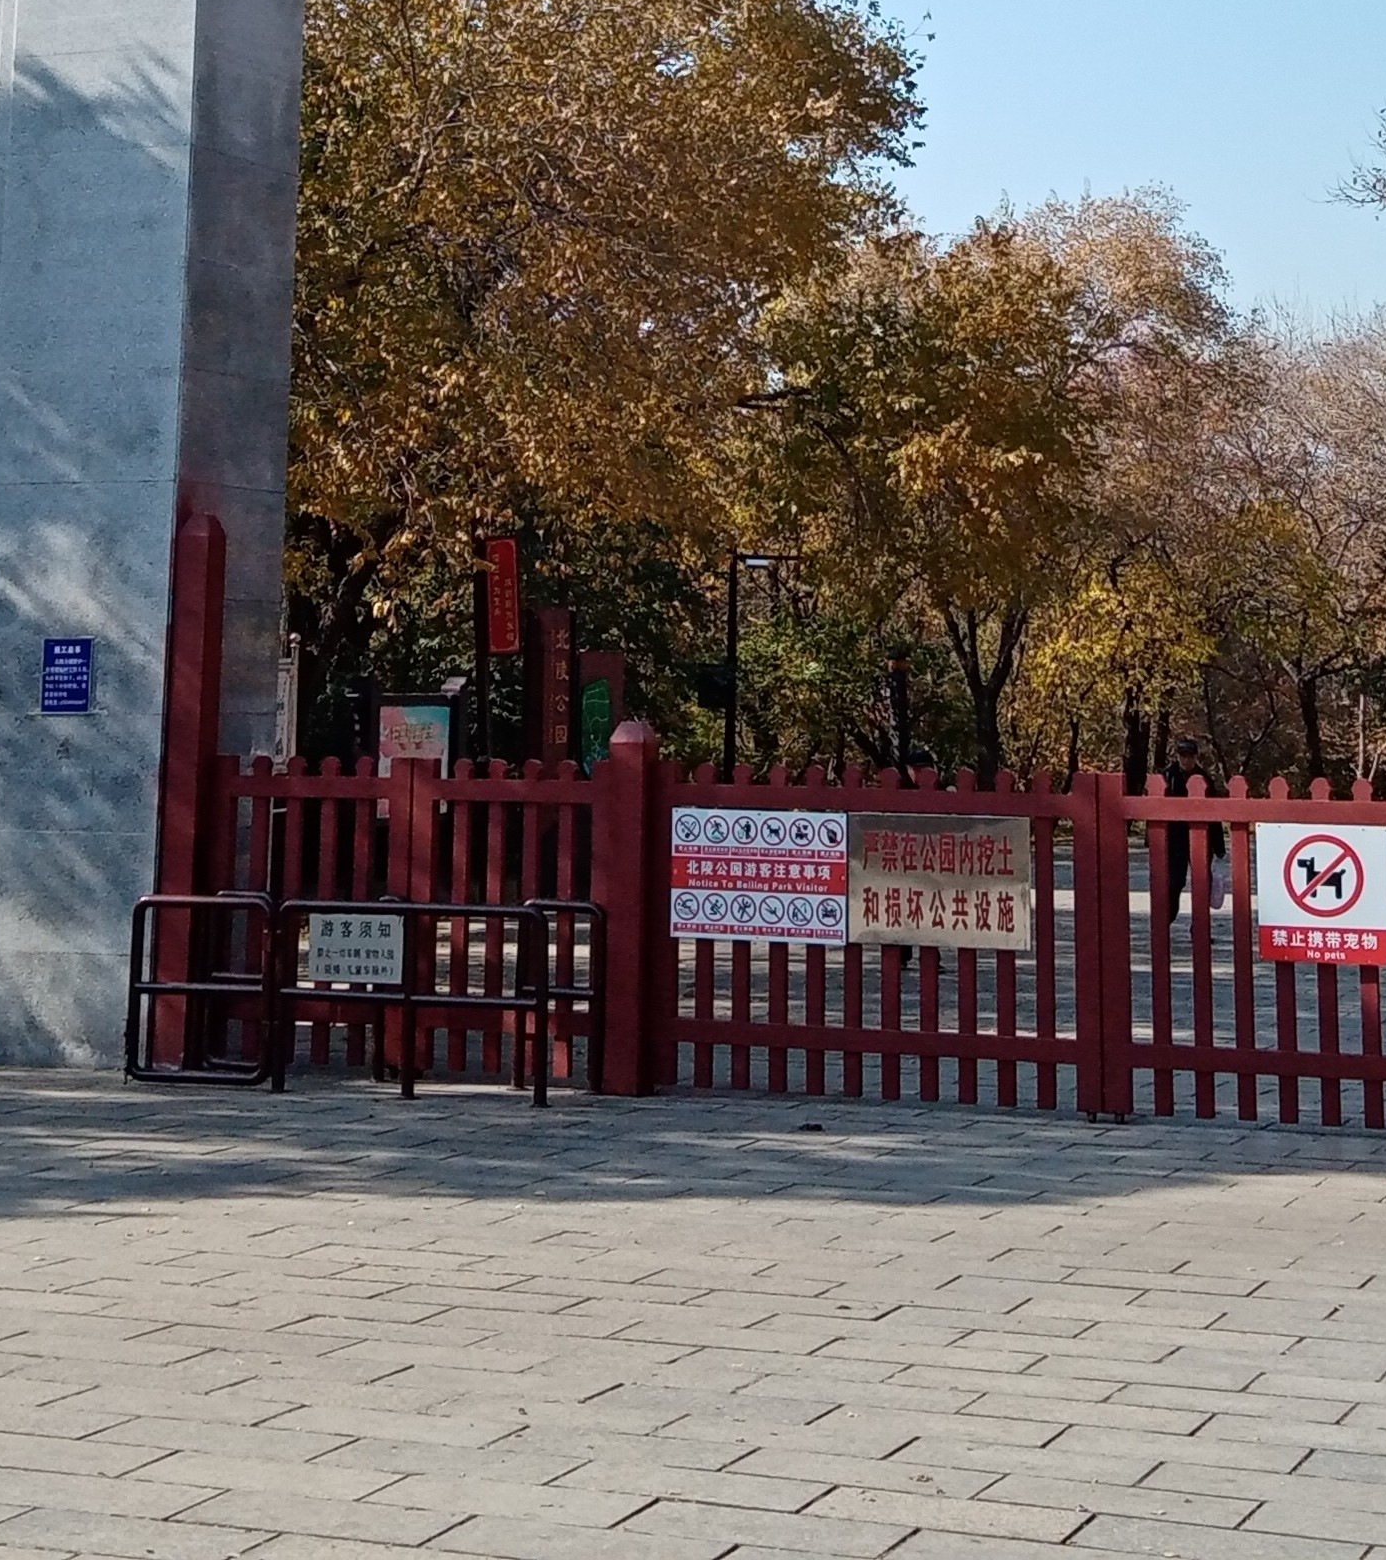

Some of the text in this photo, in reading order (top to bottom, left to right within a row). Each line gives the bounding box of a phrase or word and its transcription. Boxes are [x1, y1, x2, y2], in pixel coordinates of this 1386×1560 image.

[863, 830, 1014, 876] 严禁在公园内挖土
[686, 859, 831, 881] 北陵公园游客注意事项
[688, 878, 719, 888] Notice
[722, 879, 733, 888] To
[772, 881, 792, 891] Park
[795, 882, 828, 893] Visitor
[863, 886, 1015, 933] 和损坏公共设施
[320, 920, 391, 938] 游客须知
[1272, 928, 1379, 951] 禁止携带宠物
[1306, 950, 1346, 961] No pets
